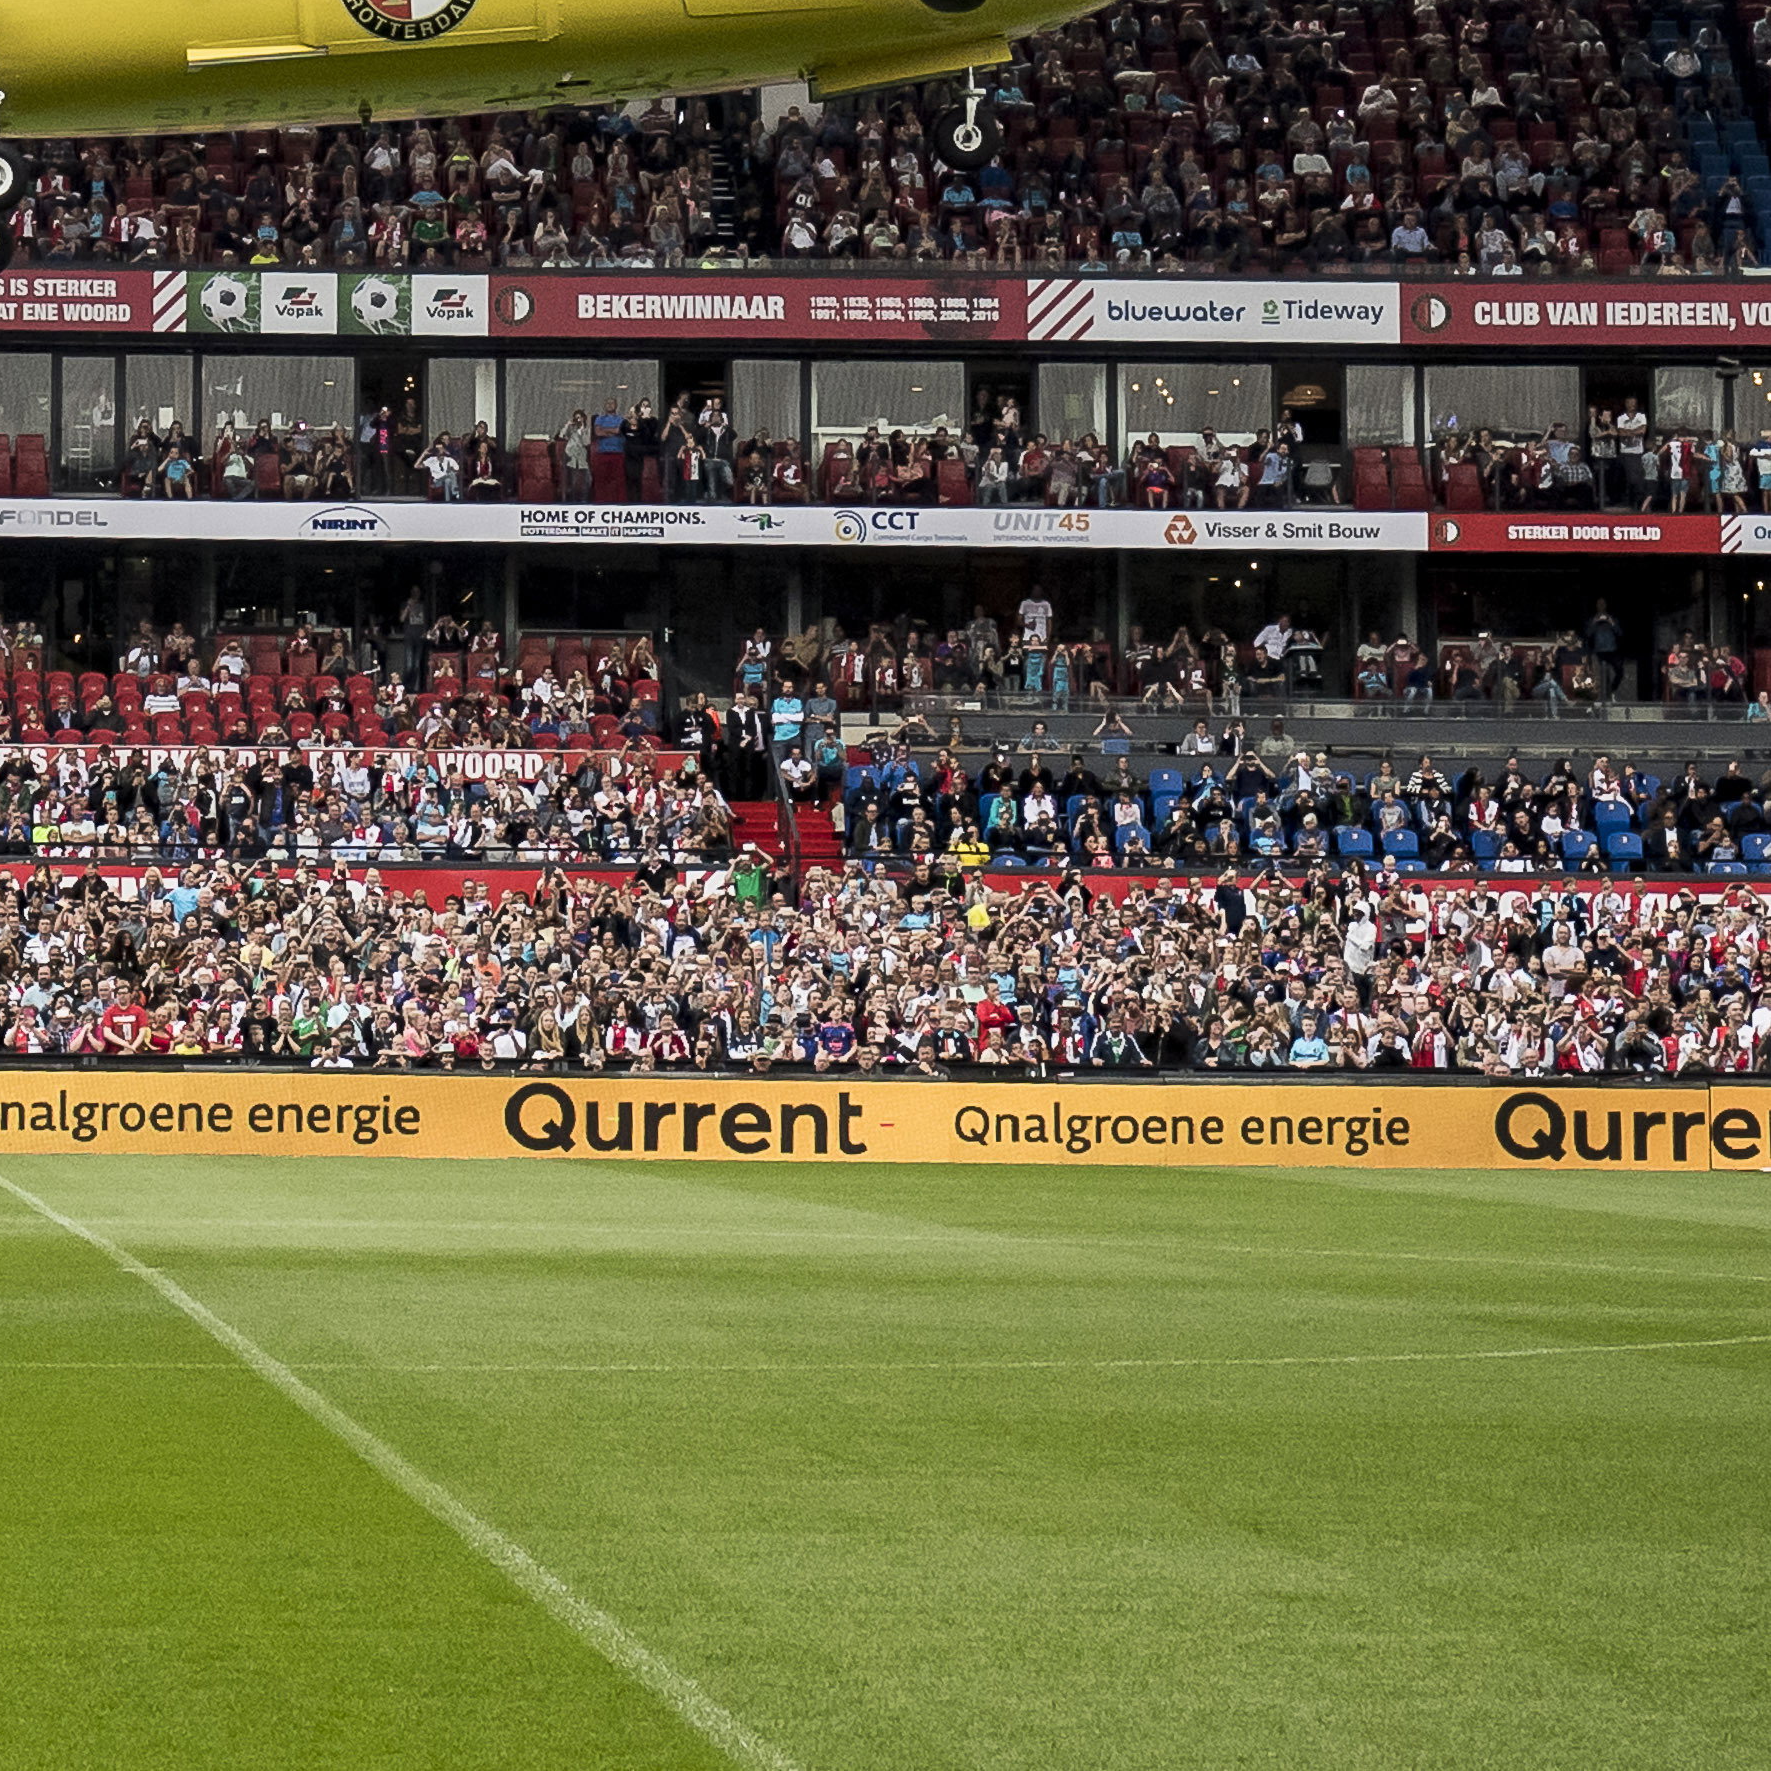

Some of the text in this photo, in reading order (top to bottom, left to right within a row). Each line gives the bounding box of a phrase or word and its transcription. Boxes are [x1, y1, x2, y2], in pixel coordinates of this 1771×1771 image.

[10, 279, 29, 296] IS
[33, 279, 117, 298] STERKER
[22, 303, 59, 321] ENE
[62, 303, 131, 322] WOORD
[275, 303, 324, 320] Vopak
[426, 305, 475, 322] Vopak
[577, 293, 786, 321] BEKERWINNAAR
[1107, 299, 1247, 322] bluewater
[1283, 298, 1384, 324] Tideway
[1474, 301, 1541, 326] CLUB
[1546, 302, 1599, 326] VAN
[1606, 302, 1737, 331] IEDEREEN,
[0, 509, 108, 527] FONDEL
[312, 518, 377, 531] NIRINT
[520, 510, 706, 525] HOME OF CHAMPIONS.
[871, 511, 920, 531] CCT
[993, 513, 1090, 532] UNIT45
[582, 527, 608, 536] MAKE
[1204, 523, 1381, 540] Visser & Smit Bouw
[1508, 525, 1661, 541] STERKER DOOR STRIJD
[248, 1095, 421, 1145] energie
[504, 1082, 868, 1154] Qurrent
[1494, 1091, 1771, 1161] Qurre
[954, 1102, 1410, 1156] Qnalgroene energie
